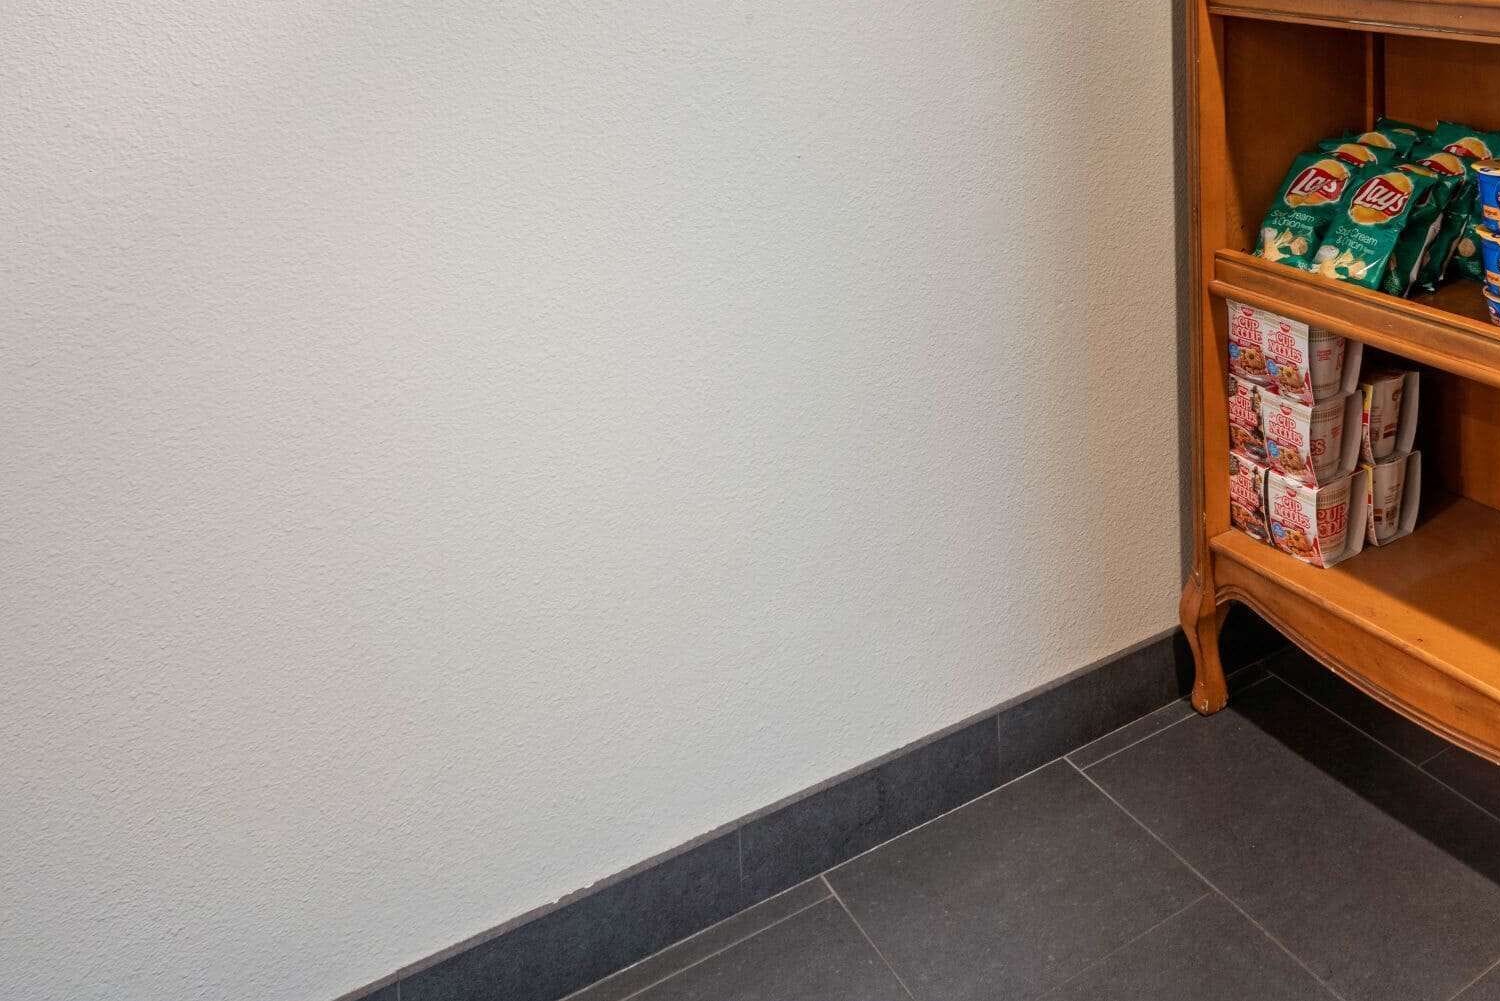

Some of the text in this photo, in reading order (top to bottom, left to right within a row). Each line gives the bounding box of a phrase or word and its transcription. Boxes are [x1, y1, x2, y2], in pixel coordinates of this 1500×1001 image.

[1354, 179, 1408, 214] Lay's
[1239, 316, 1260, 329] CUP
[1276, 331, 1296, 346] CUP
[1277, 413, 1296, 429] CUP
[1282, 495, 1302, 511] CUP
